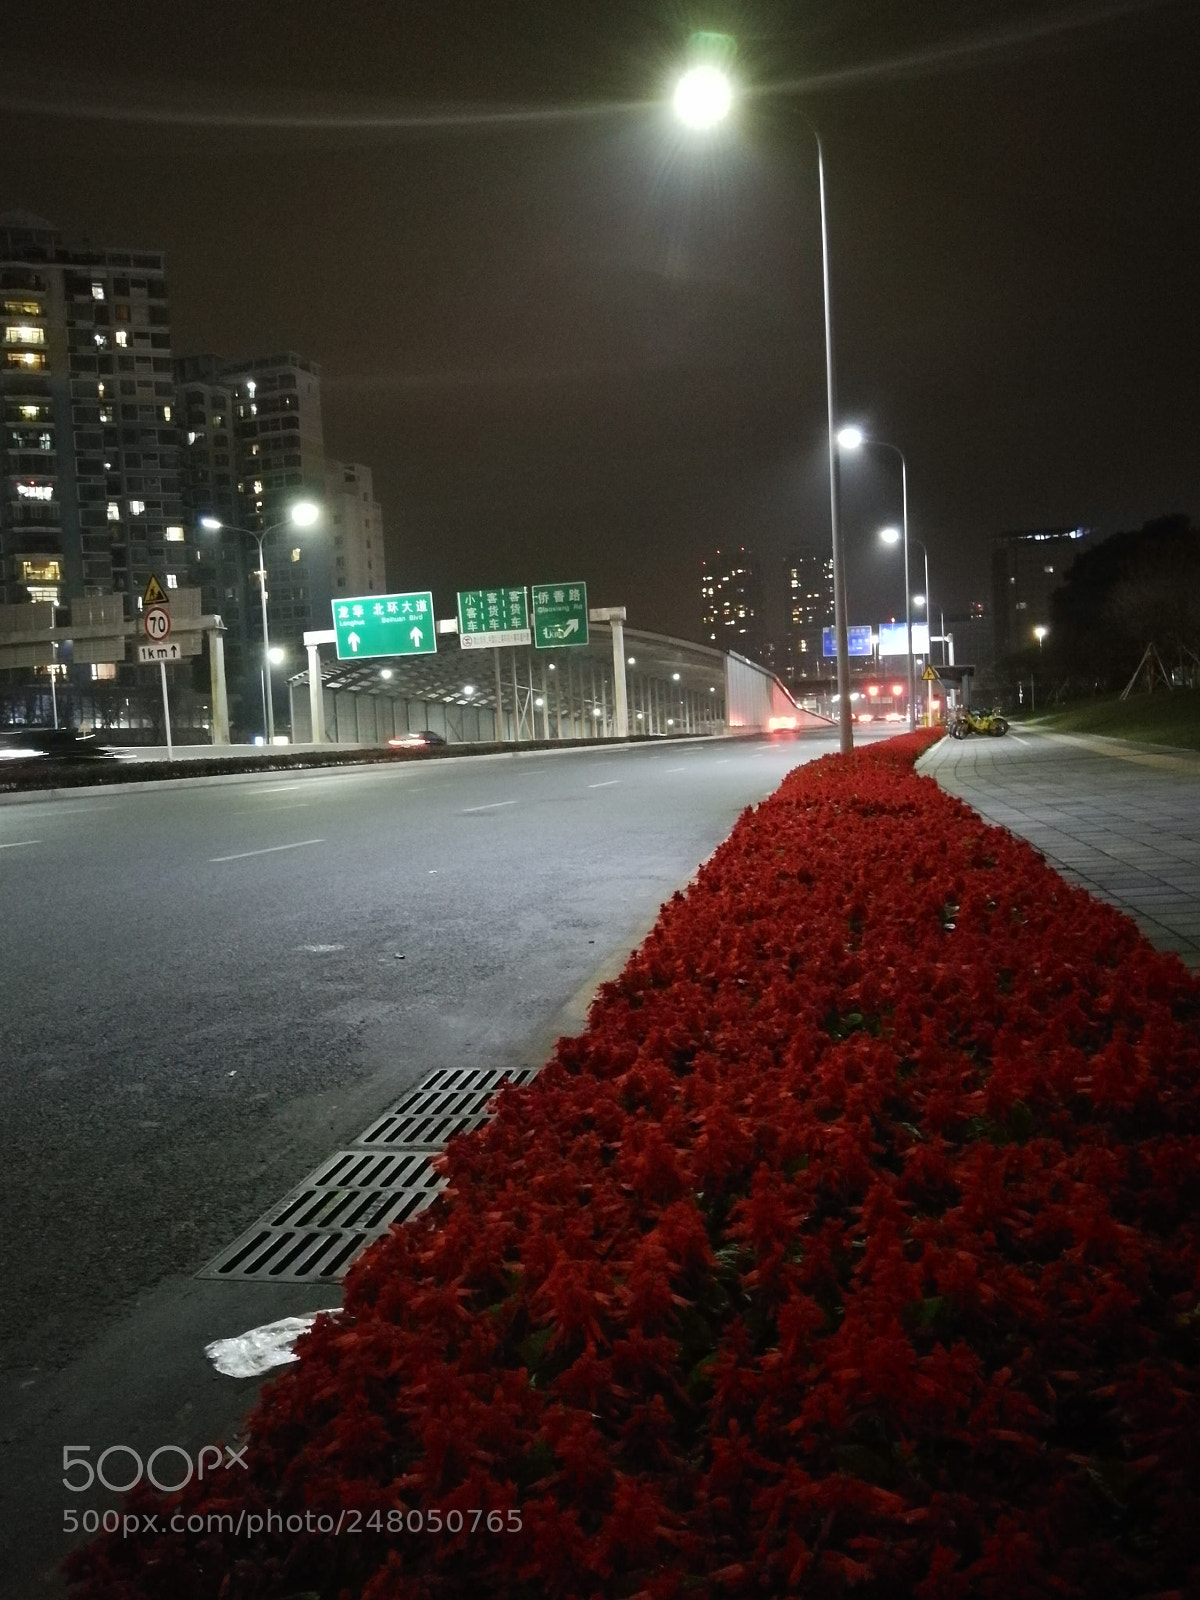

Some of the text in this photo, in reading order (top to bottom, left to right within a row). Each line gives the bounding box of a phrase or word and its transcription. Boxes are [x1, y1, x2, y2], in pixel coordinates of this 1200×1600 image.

[373, 599, 428, 616] 北环大道
[381, 615, 406, 623] Beihuan
[465, 594, 478, 632] 小客车
[487, 592, 500, 630] 客货车
[509, 590, 522, 628] 客货车
[149, 616, 165, 633] 70
